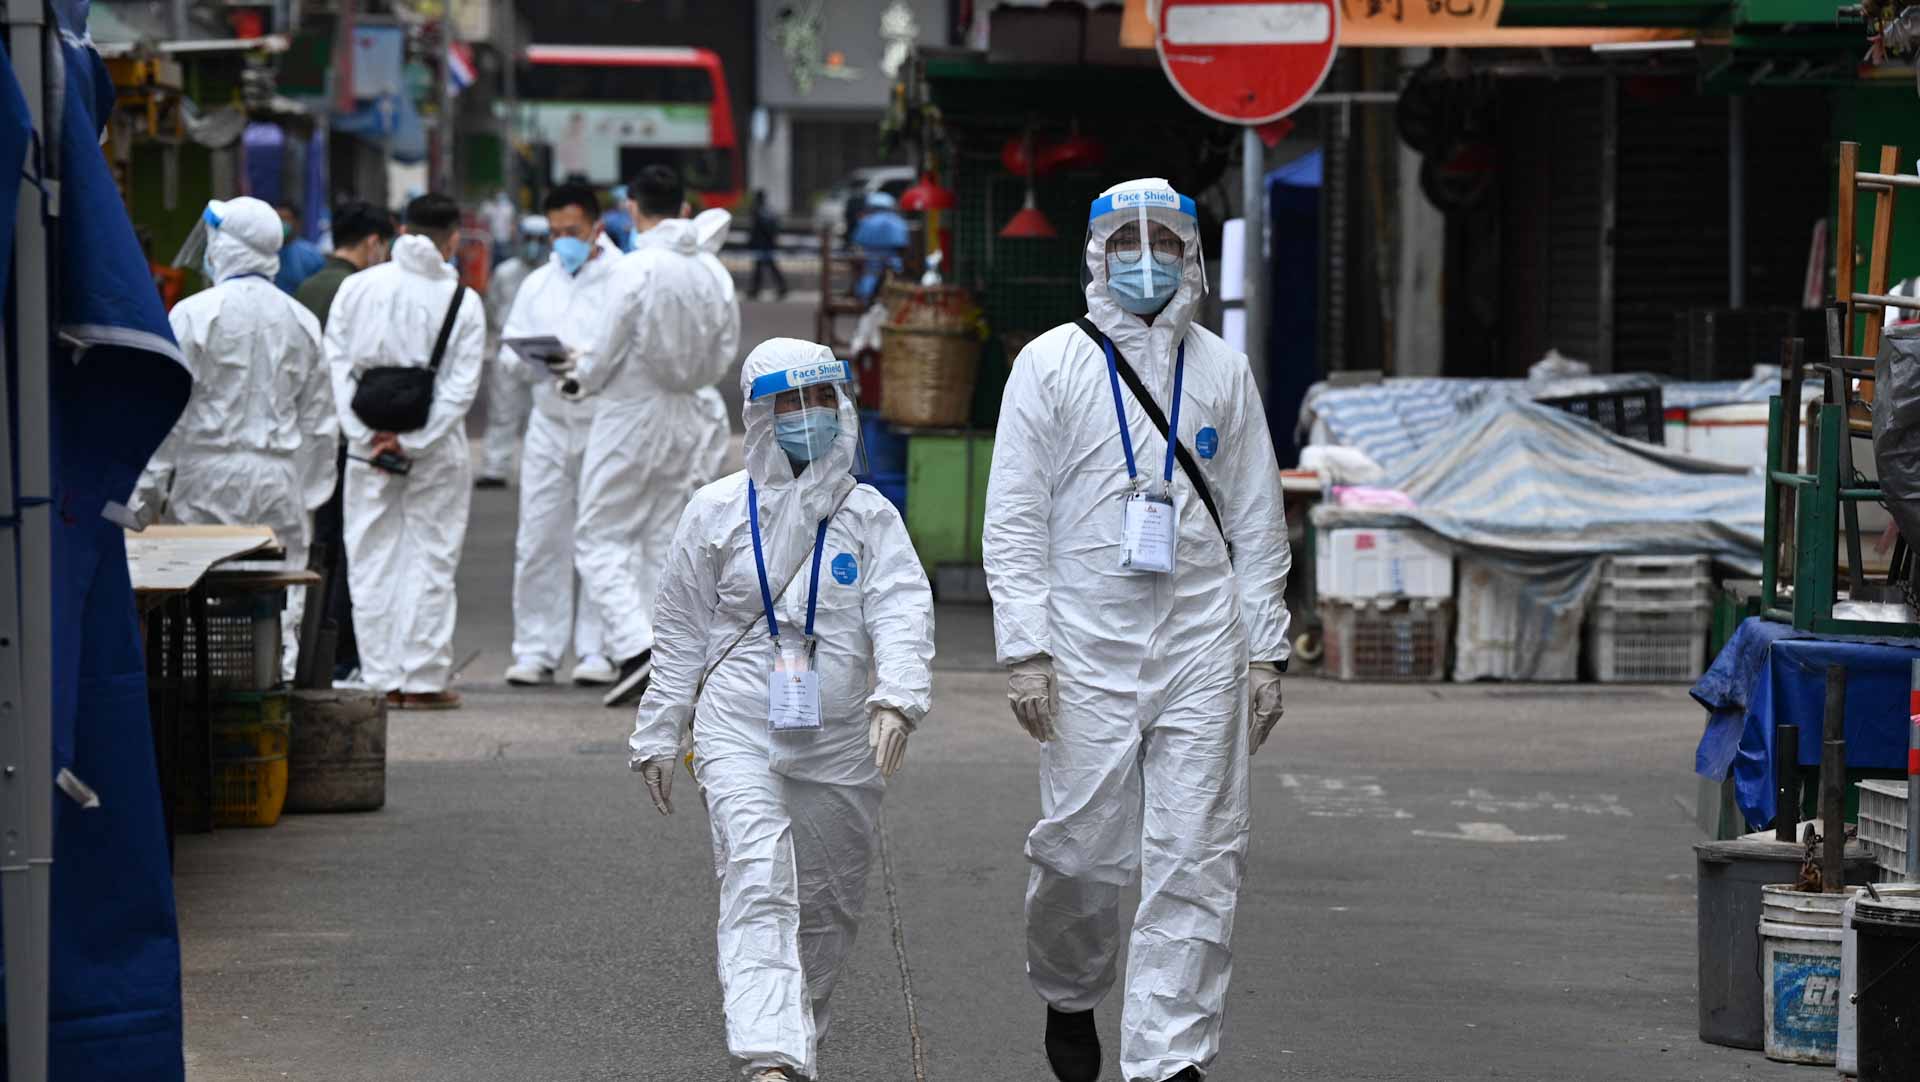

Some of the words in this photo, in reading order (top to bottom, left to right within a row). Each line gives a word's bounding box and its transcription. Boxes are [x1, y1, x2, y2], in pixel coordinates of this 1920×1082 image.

[1117, 192, 1140, 203] Face
[1143, 190, 1175, 203] Shield
[792, 369, 816, 380] Face
[818, 362, 842, 375] Shield
